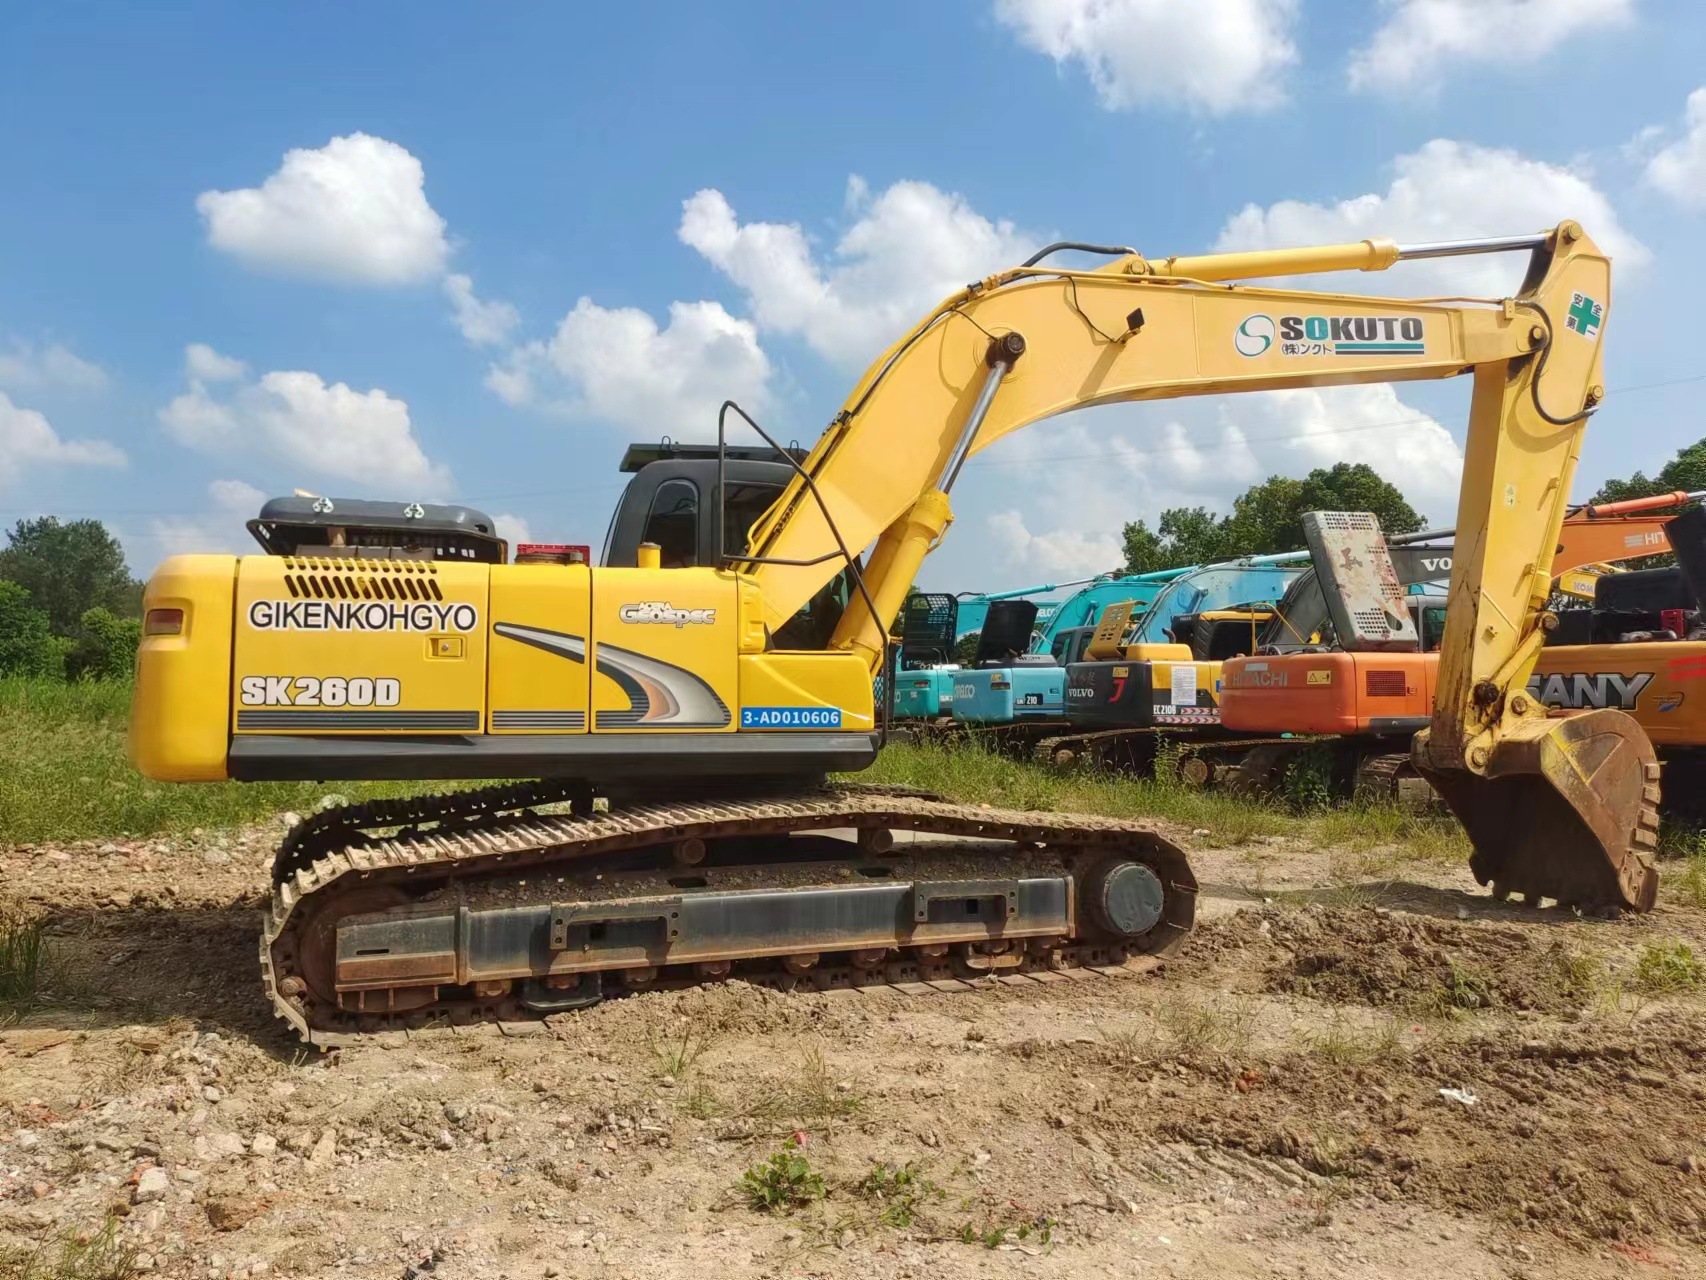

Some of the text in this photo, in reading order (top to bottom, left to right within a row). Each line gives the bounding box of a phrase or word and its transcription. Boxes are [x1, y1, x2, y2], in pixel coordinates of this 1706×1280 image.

[1279, 316, 1424, 341] SOKUTO
[249, 600, 477, 631] GIKENKOHGYO
[1233, 671, 1288, 687] HACHI
[240, 676, 401, 707] SK260D
[1068, 688, 1094, 698] VOLVO
[743, 710, 840, 725] 3-AD010606
